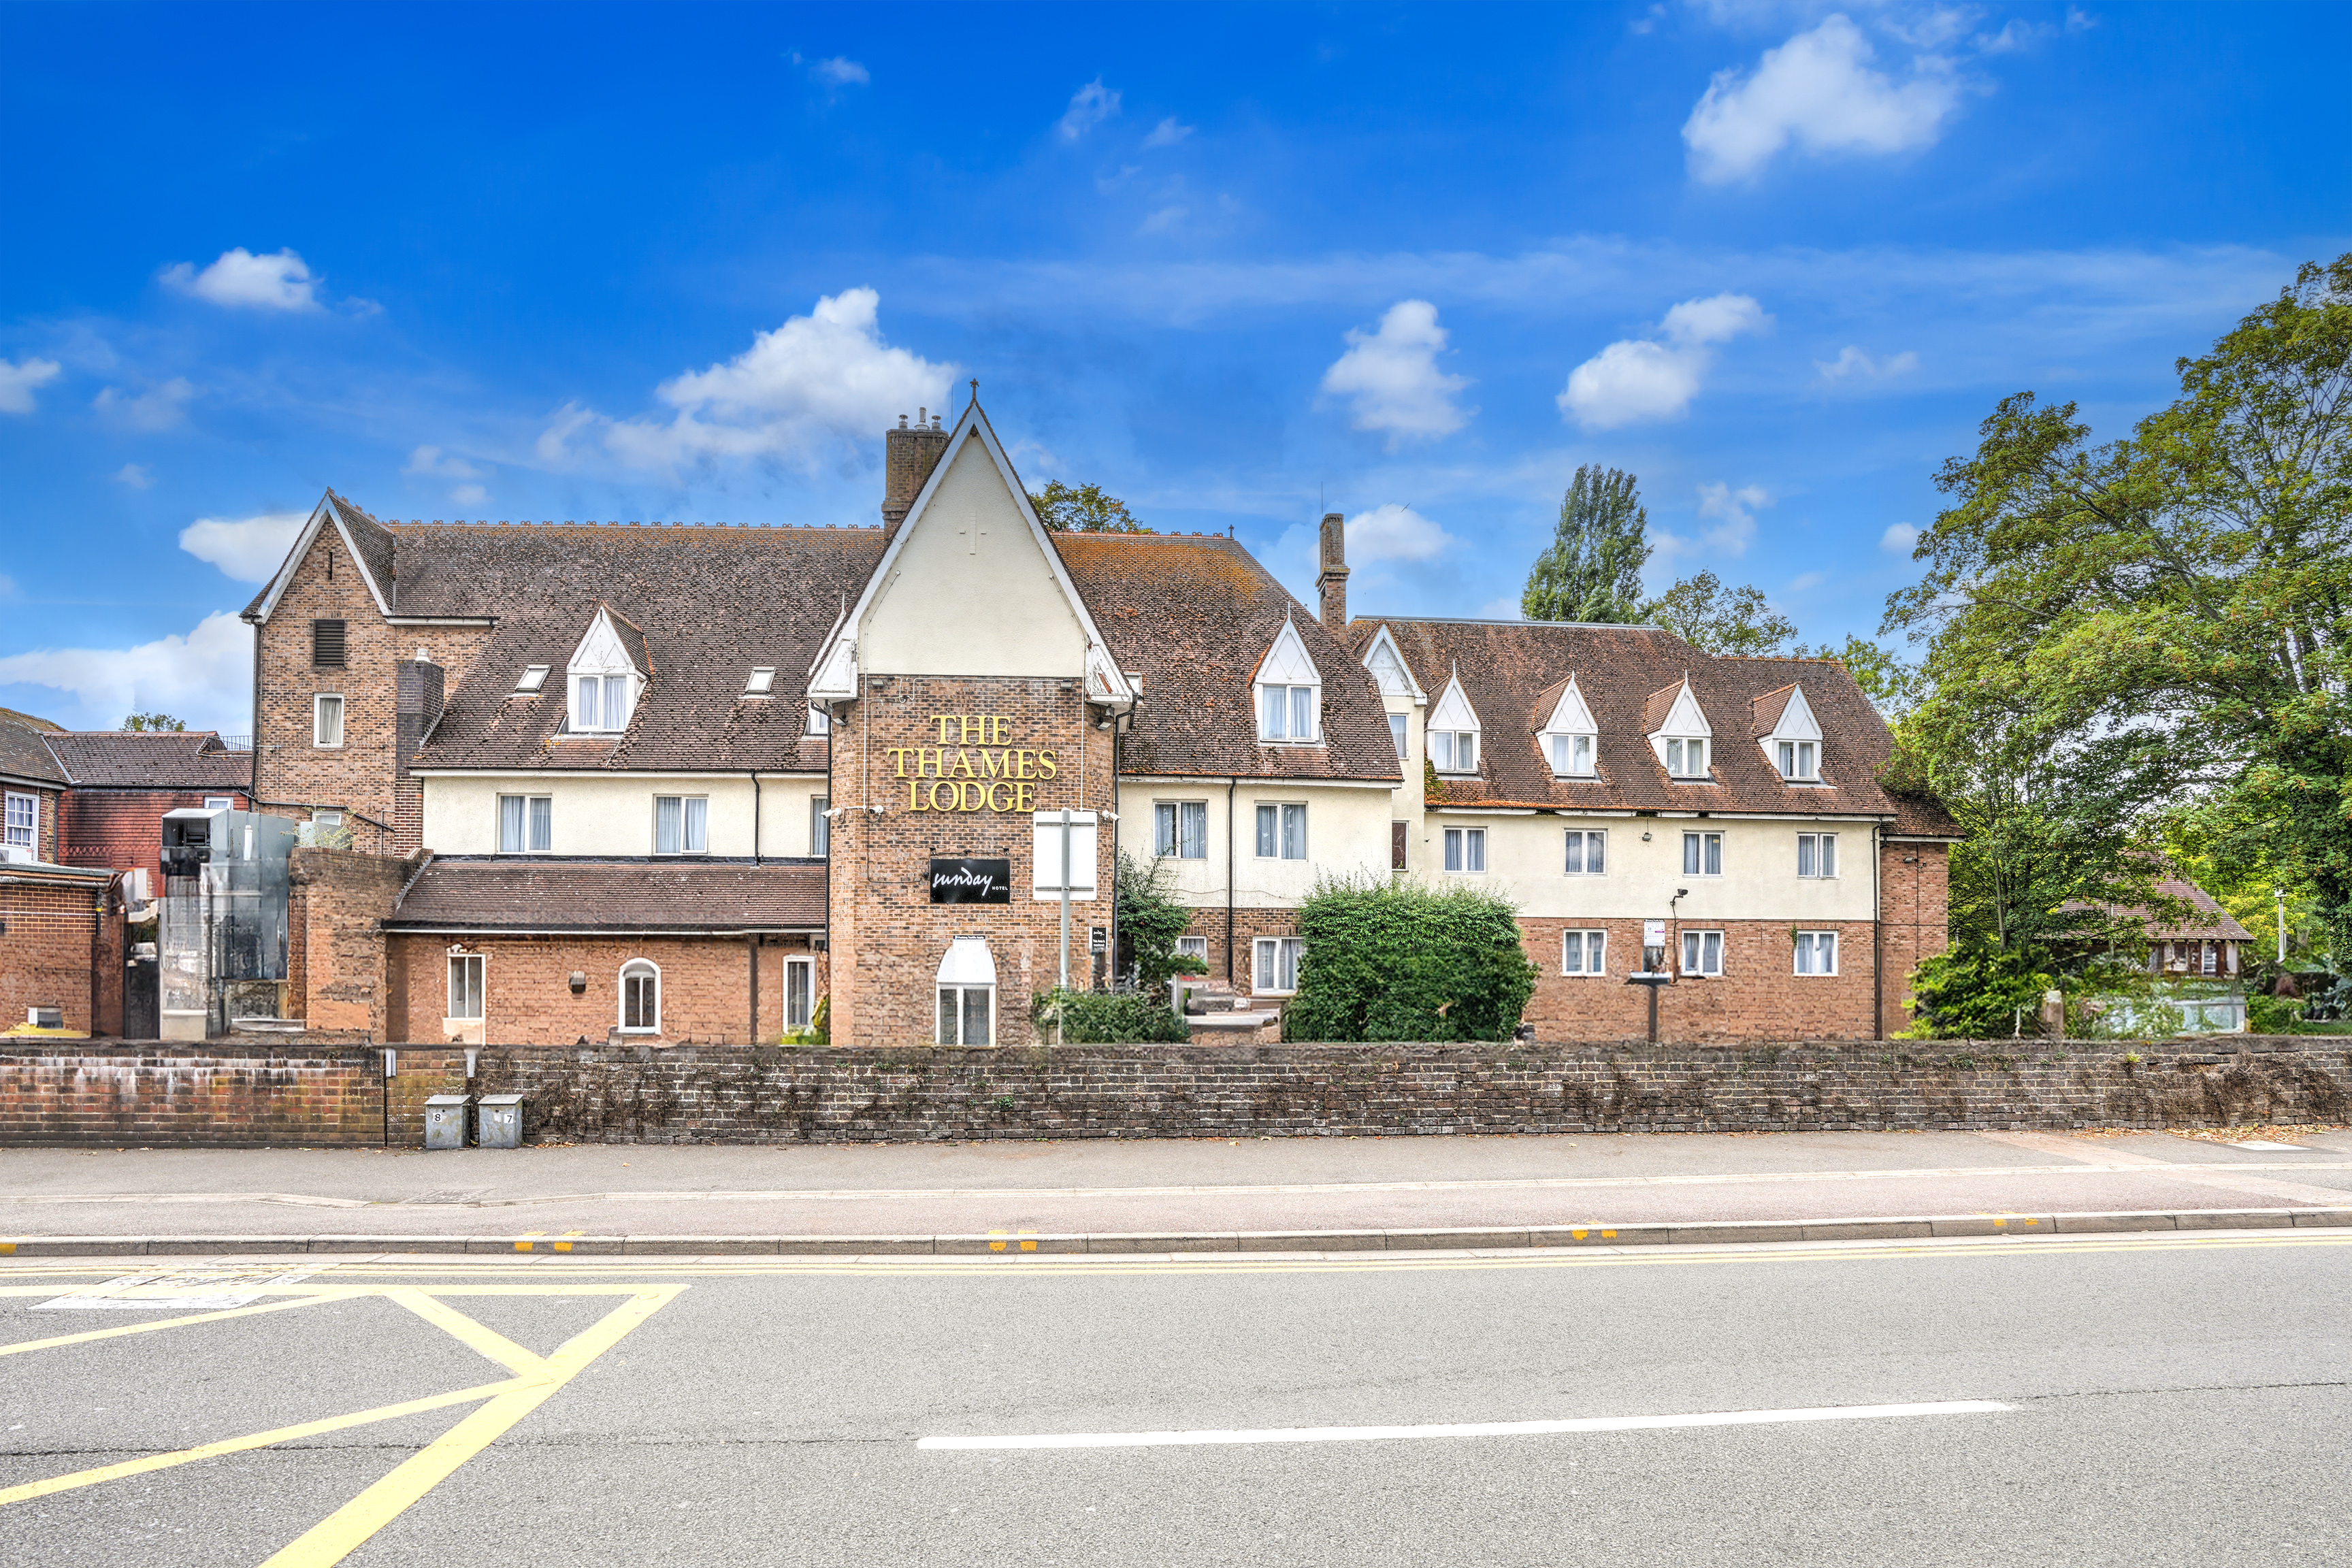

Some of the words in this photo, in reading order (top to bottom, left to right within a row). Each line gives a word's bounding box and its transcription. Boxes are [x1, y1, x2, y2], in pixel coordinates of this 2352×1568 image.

[930, 715, 1013, 746] THE
[887, 747, 1057, 780] THAMES
[906, 781, 1036, 813] LODGE
[932, 866, 993, 896] sunday
[435, 1113, 441, 1122] 8
[506, 1115, 512, 1123] 7
